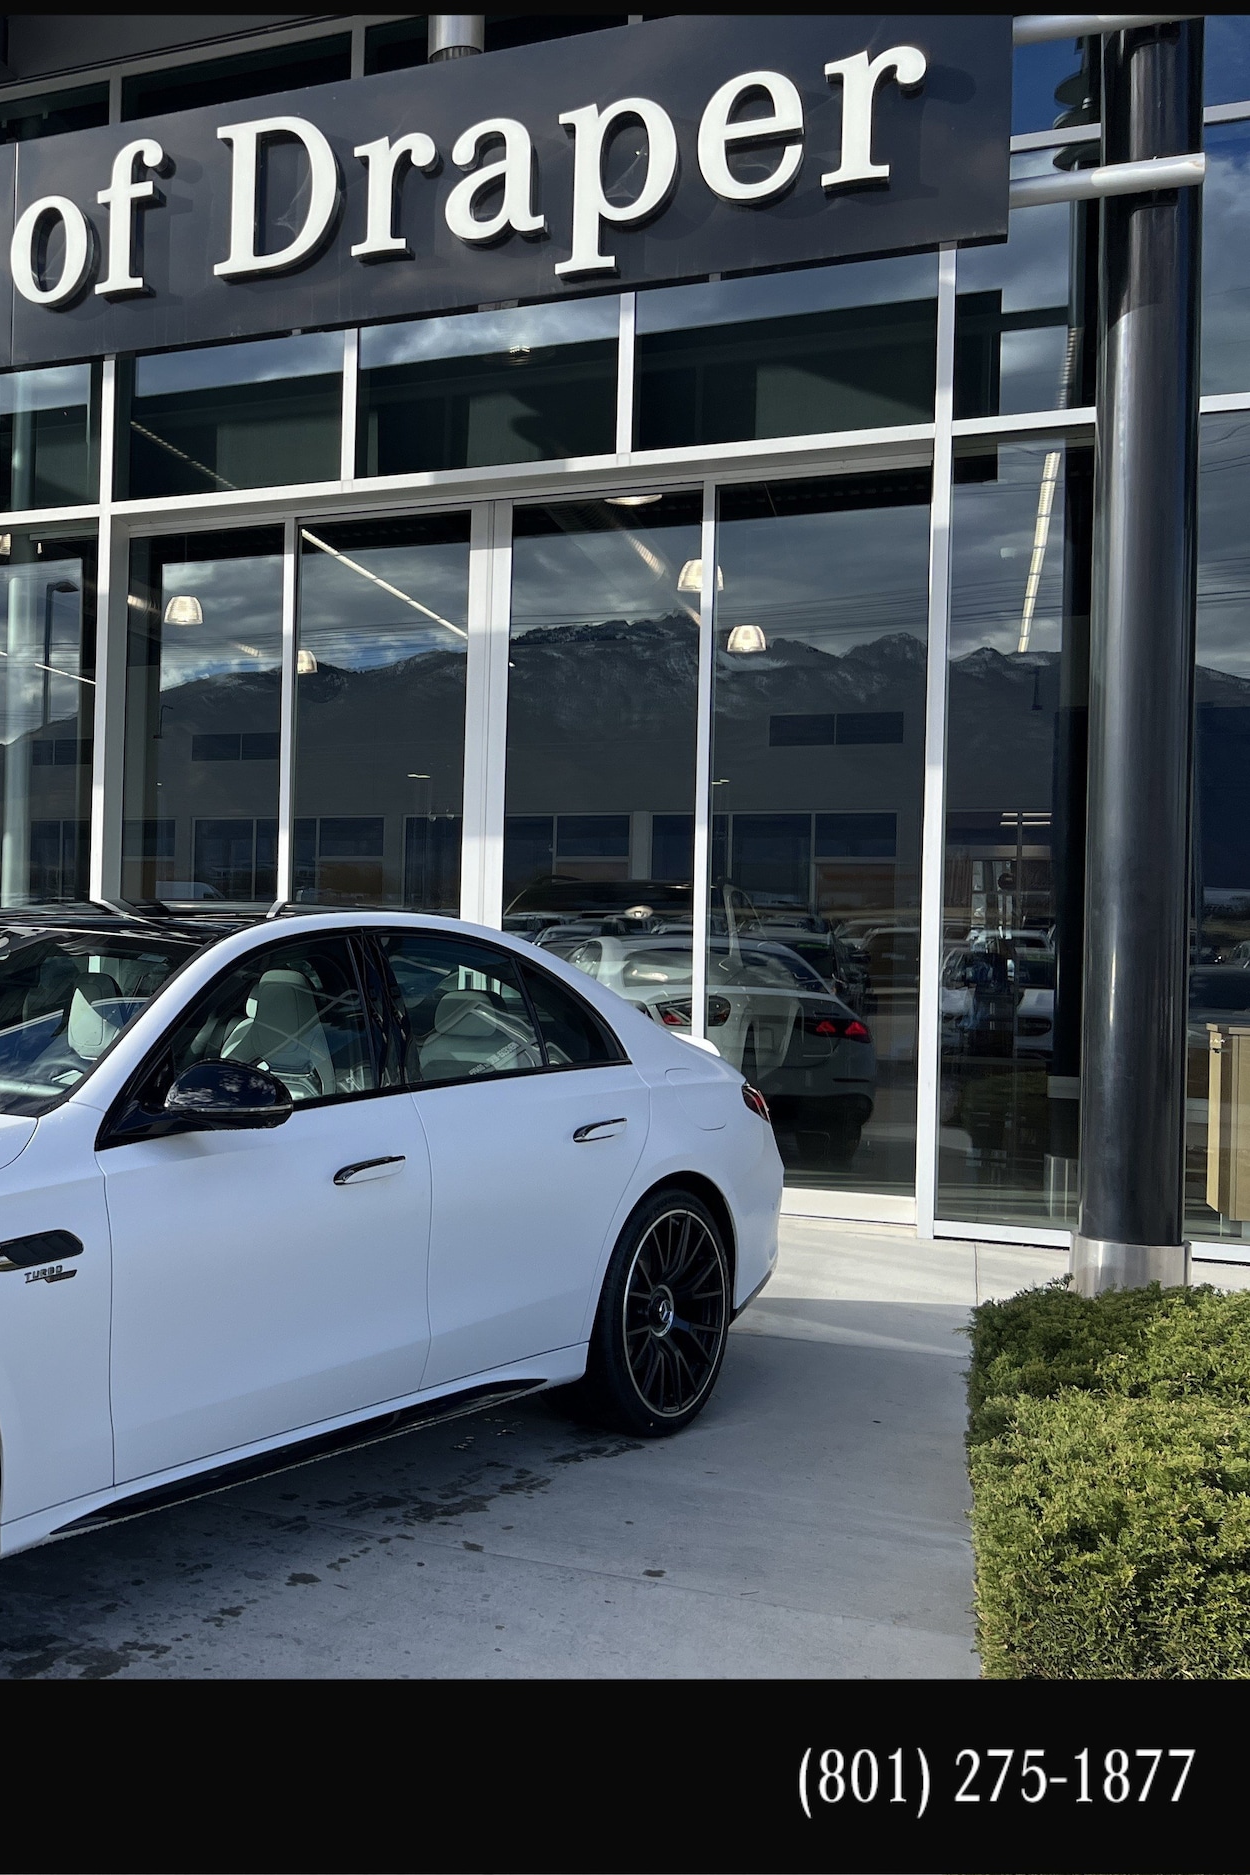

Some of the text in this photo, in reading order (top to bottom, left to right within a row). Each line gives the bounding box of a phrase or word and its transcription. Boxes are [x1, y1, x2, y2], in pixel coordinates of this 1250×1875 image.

[11, 139, 166, 306] of
[214, 45, 927, 278] Draper
[24, 1265, 63, 1281] TURBO
